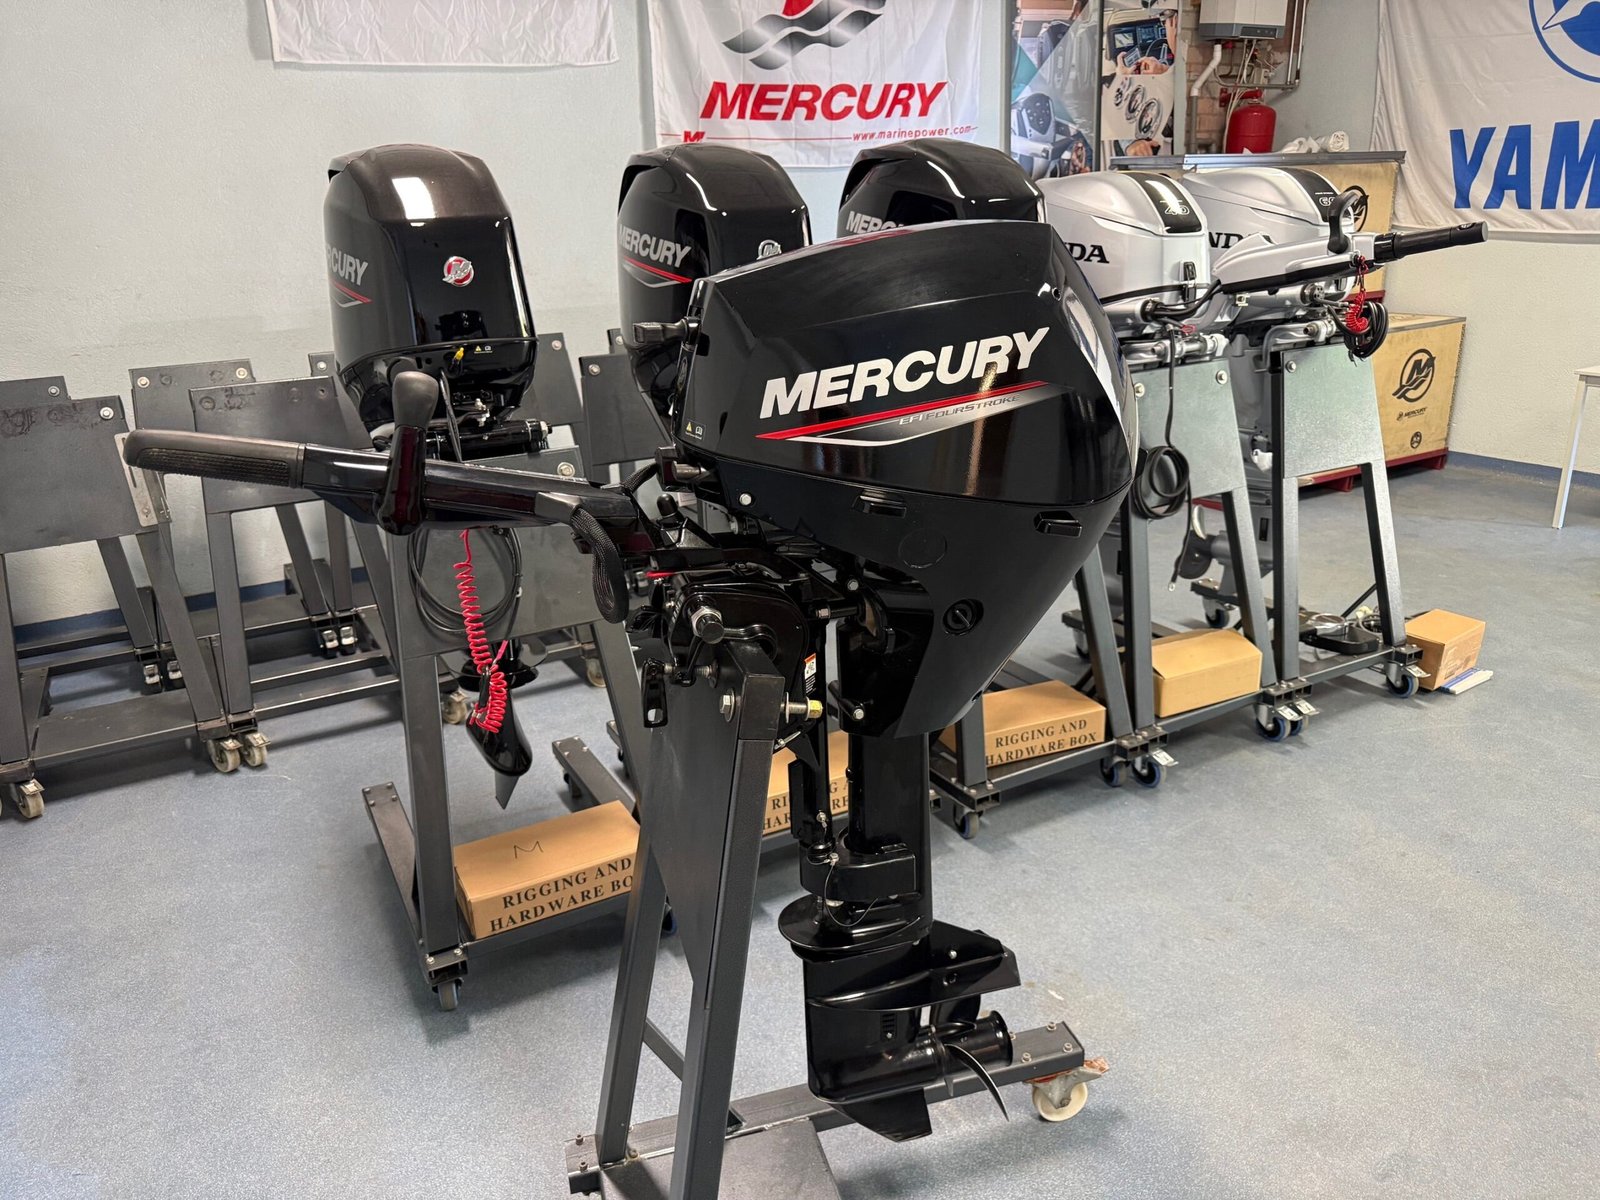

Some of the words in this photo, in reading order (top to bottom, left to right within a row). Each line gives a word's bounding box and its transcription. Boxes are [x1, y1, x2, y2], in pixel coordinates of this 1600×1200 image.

[700, 81, 948, 121] MERCURY
[853, 125, 972, 141] www.marinepower.com
[759, 327, 1050, 420] MERCURY
[985, 738, 1065, 766] HARDWARE
[1069, 731, 1099, 747] BOX
[994, 725, 1055, 749] RIGGING
[1059, 719, 1088, 735] AND
[502, 871, 587, 909] RIGGING
[594, 857, 632, 881] AND
[489, 884, 605, 933] HARDWARE
